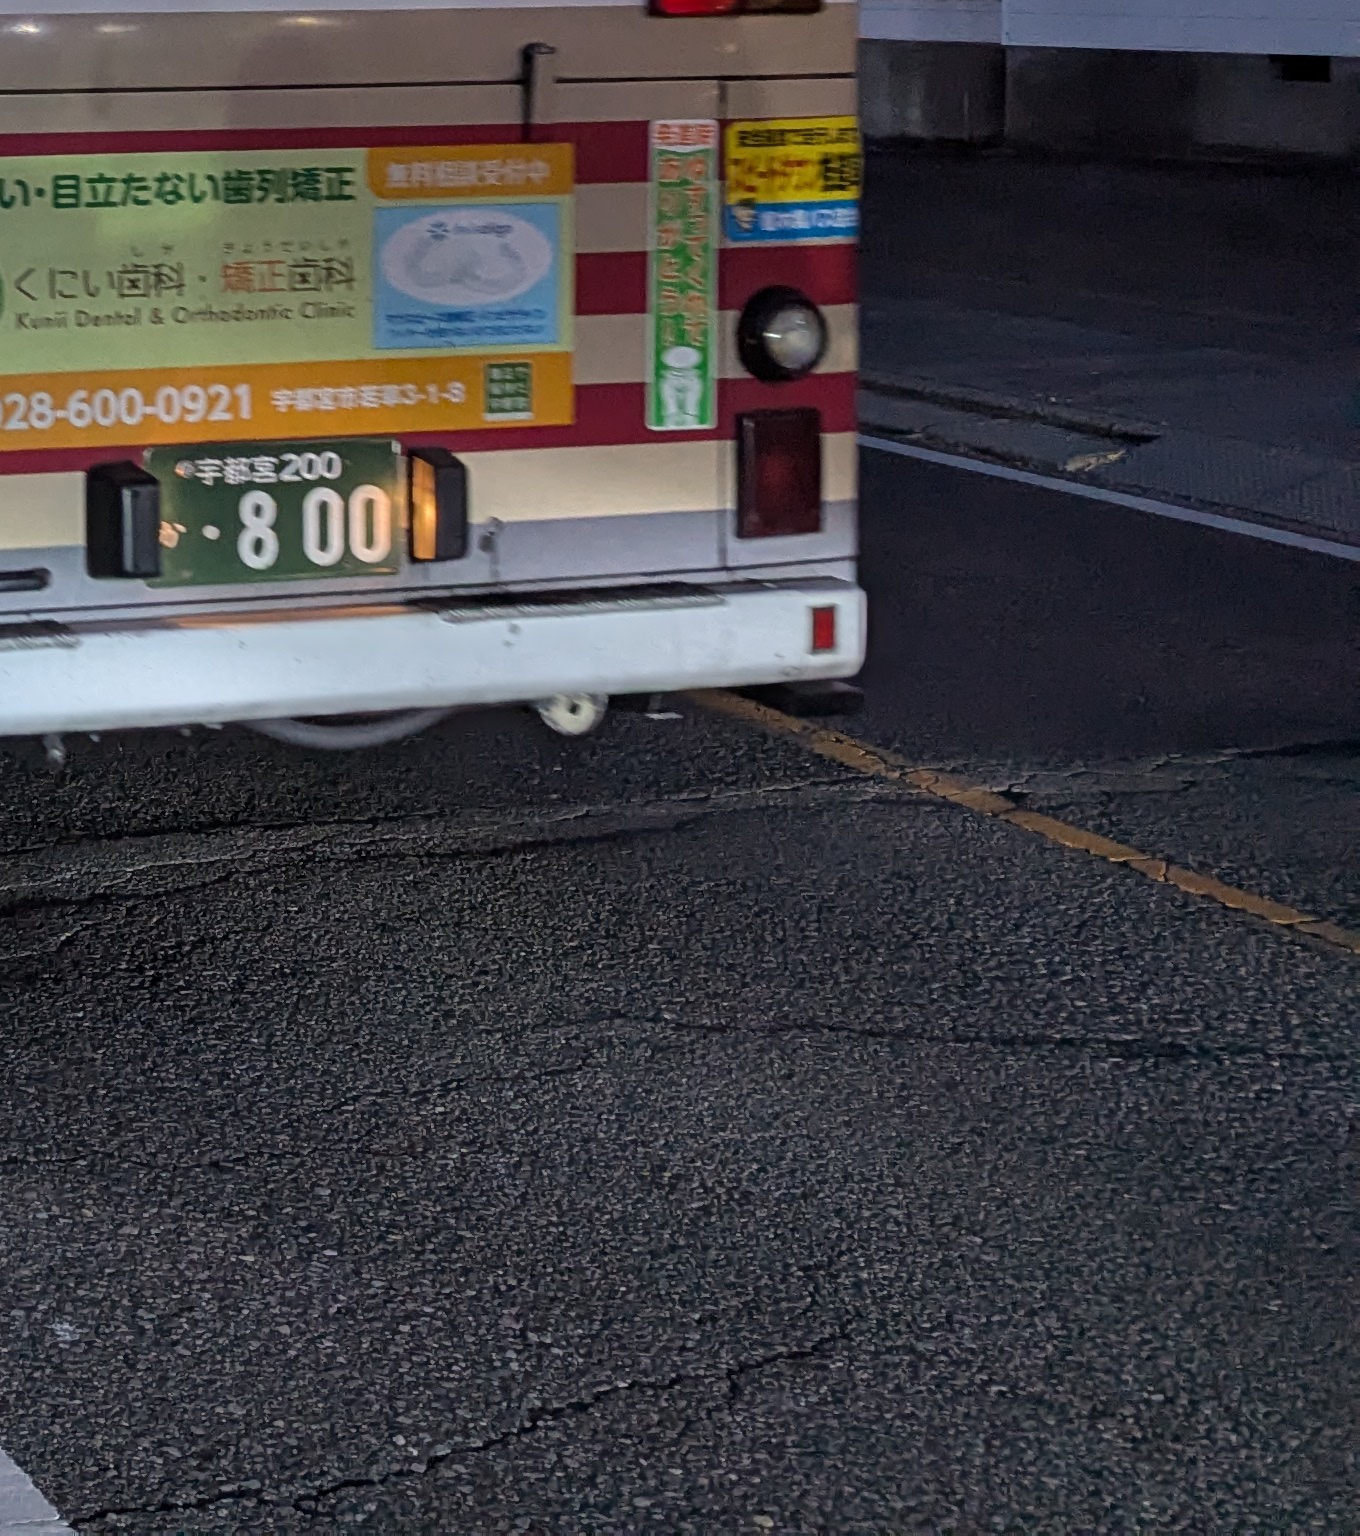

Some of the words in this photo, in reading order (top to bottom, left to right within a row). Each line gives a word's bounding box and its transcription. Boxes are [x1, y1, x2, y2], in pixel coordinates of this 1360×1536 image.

[75, 308, 142, 327] Dental
[149, 307, 165, 325] &
[176, 302, 292, 325] Orthodontic
[300, 300, 356, 320] Clinic
[194, 451, 342, 485] 宇都宮200
